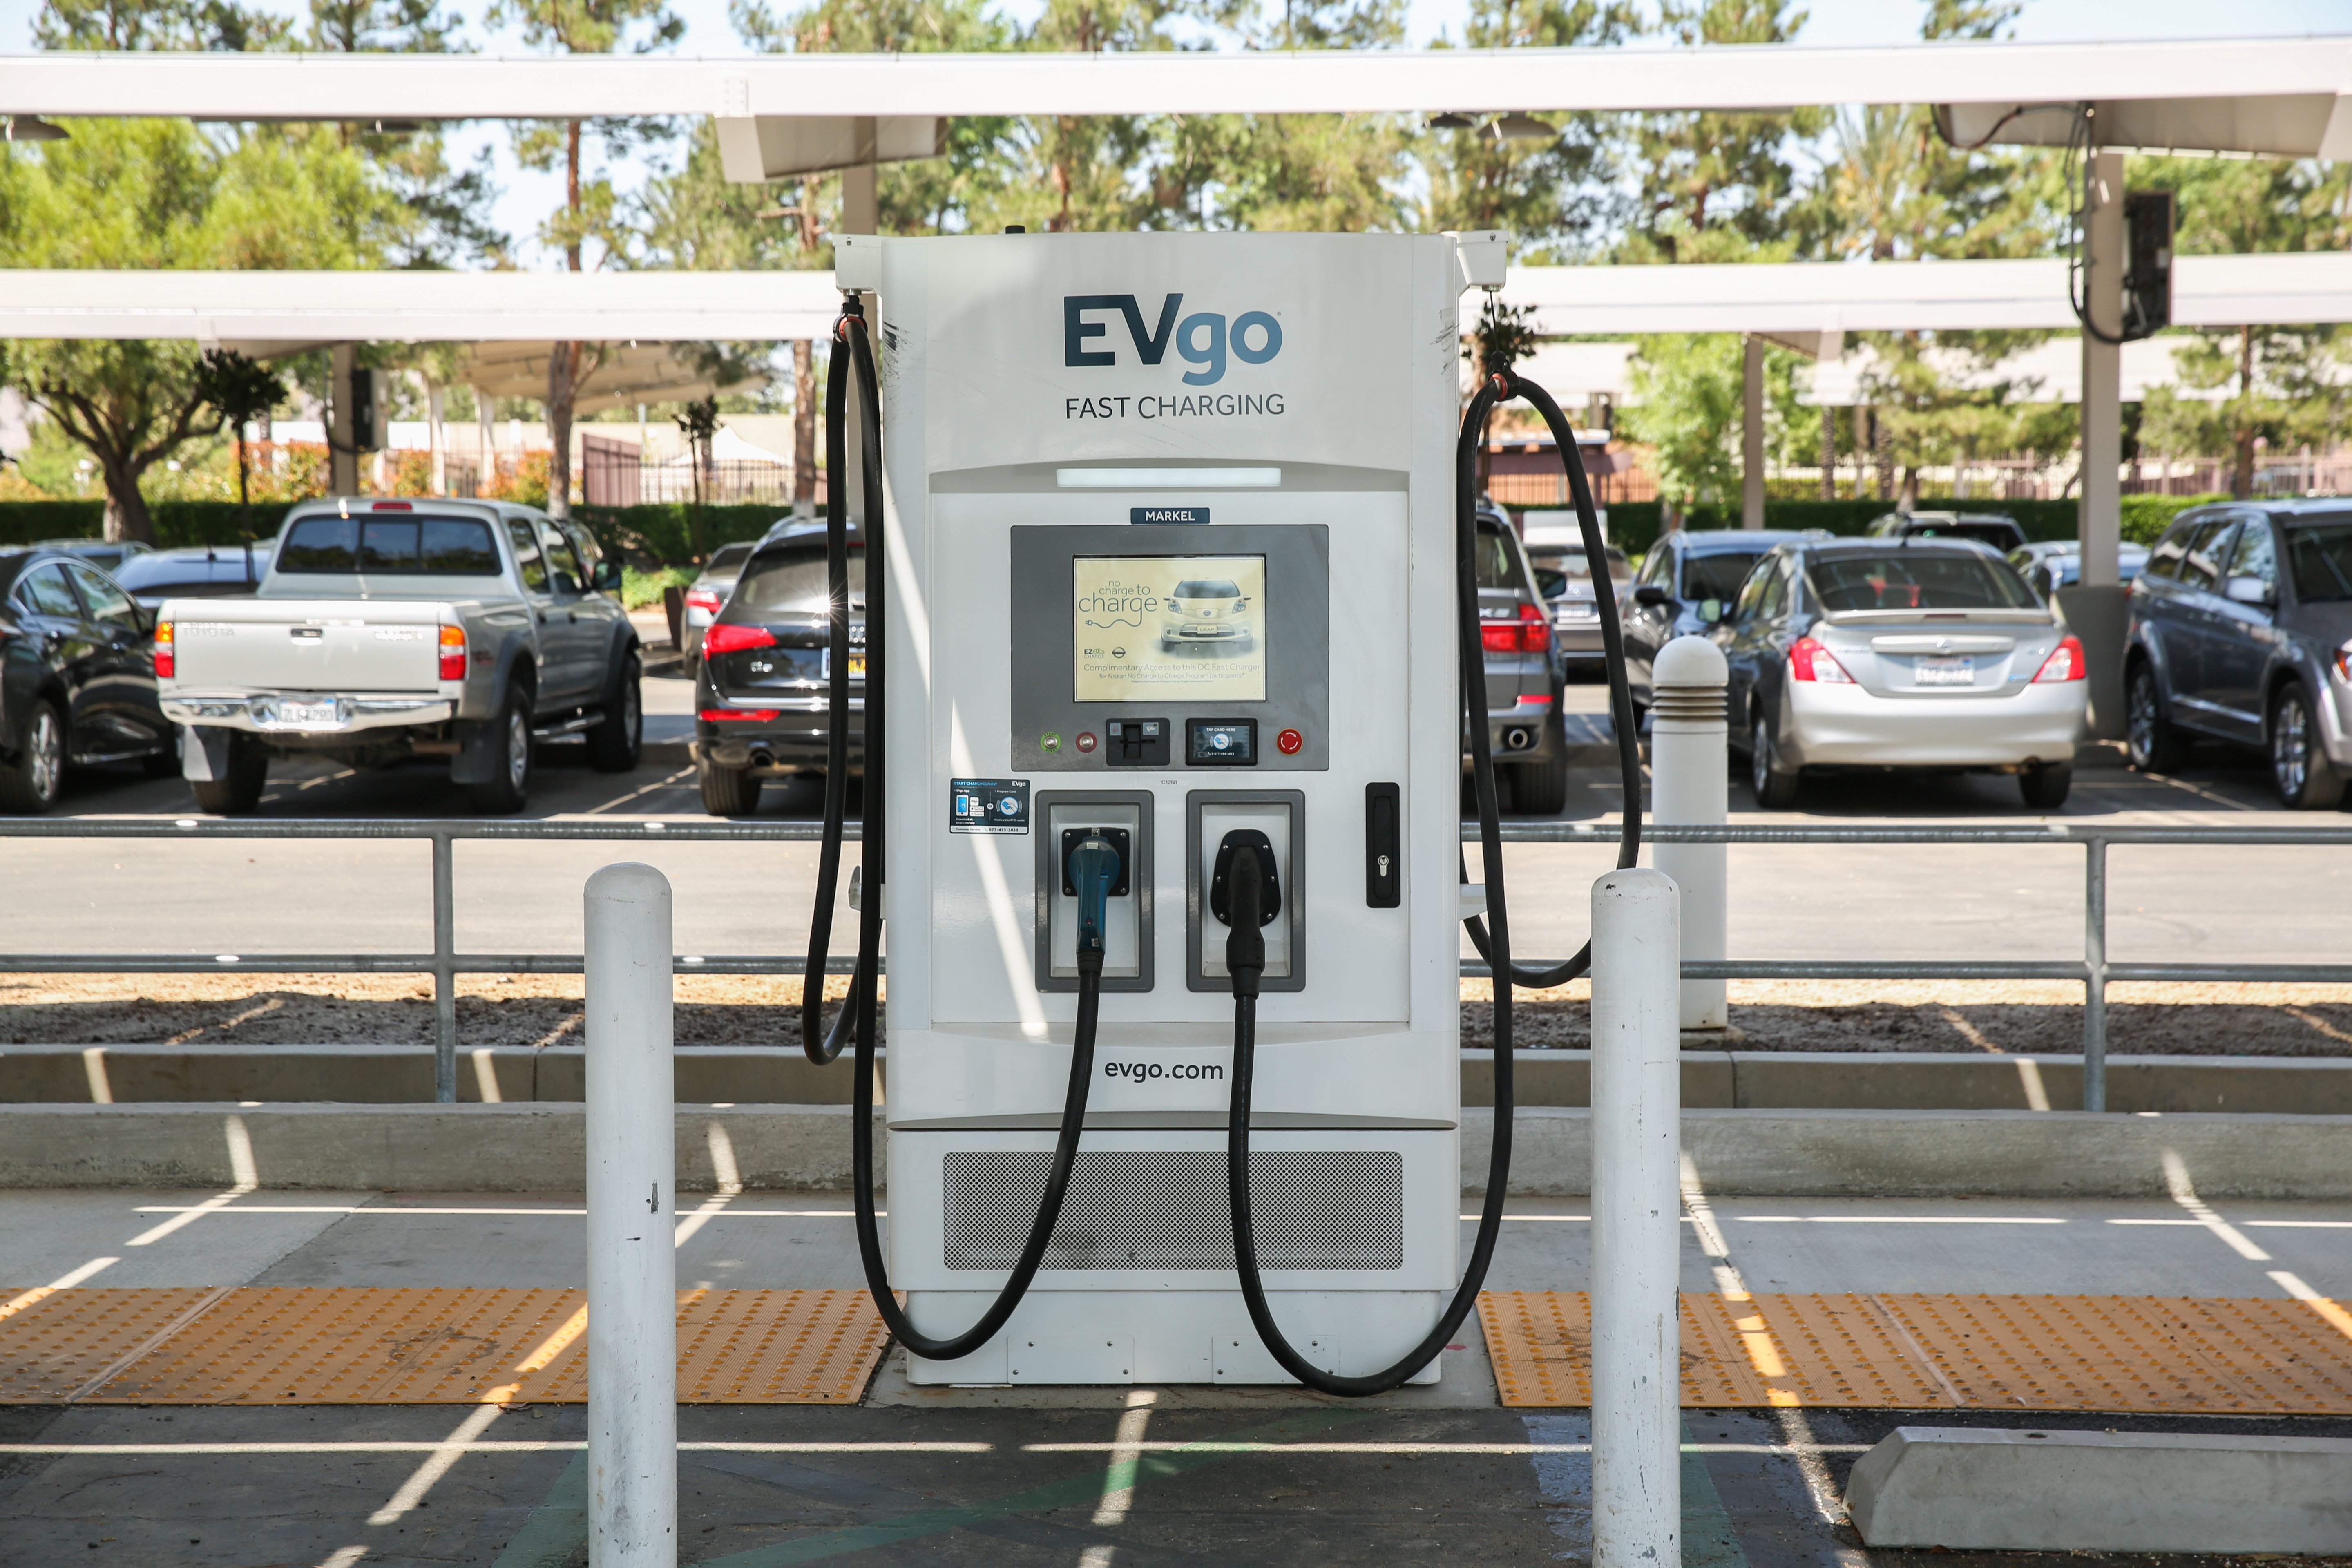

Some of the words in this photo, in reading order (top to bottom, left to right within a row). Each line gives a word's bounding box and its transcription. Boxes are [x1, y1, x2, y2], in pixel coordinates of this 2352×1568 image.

[1064, 293, 1282, 386] EVgo
[1066, 397, 1131, 419] FAST
[1138, 393, 1284, 419] CHARGING
[1146, 511, 1195, 521] MARKEL
[1099, 586, 1134, 597] charge
[1136, 584, 1150, 595] to
[1079, 592, 1157, 615] charge
[1084, 664, 1143, 672] Complimentary
[1230, 663, 1260, 672] Charger
[1105, 1062, 1223, 1083] evgo.com
